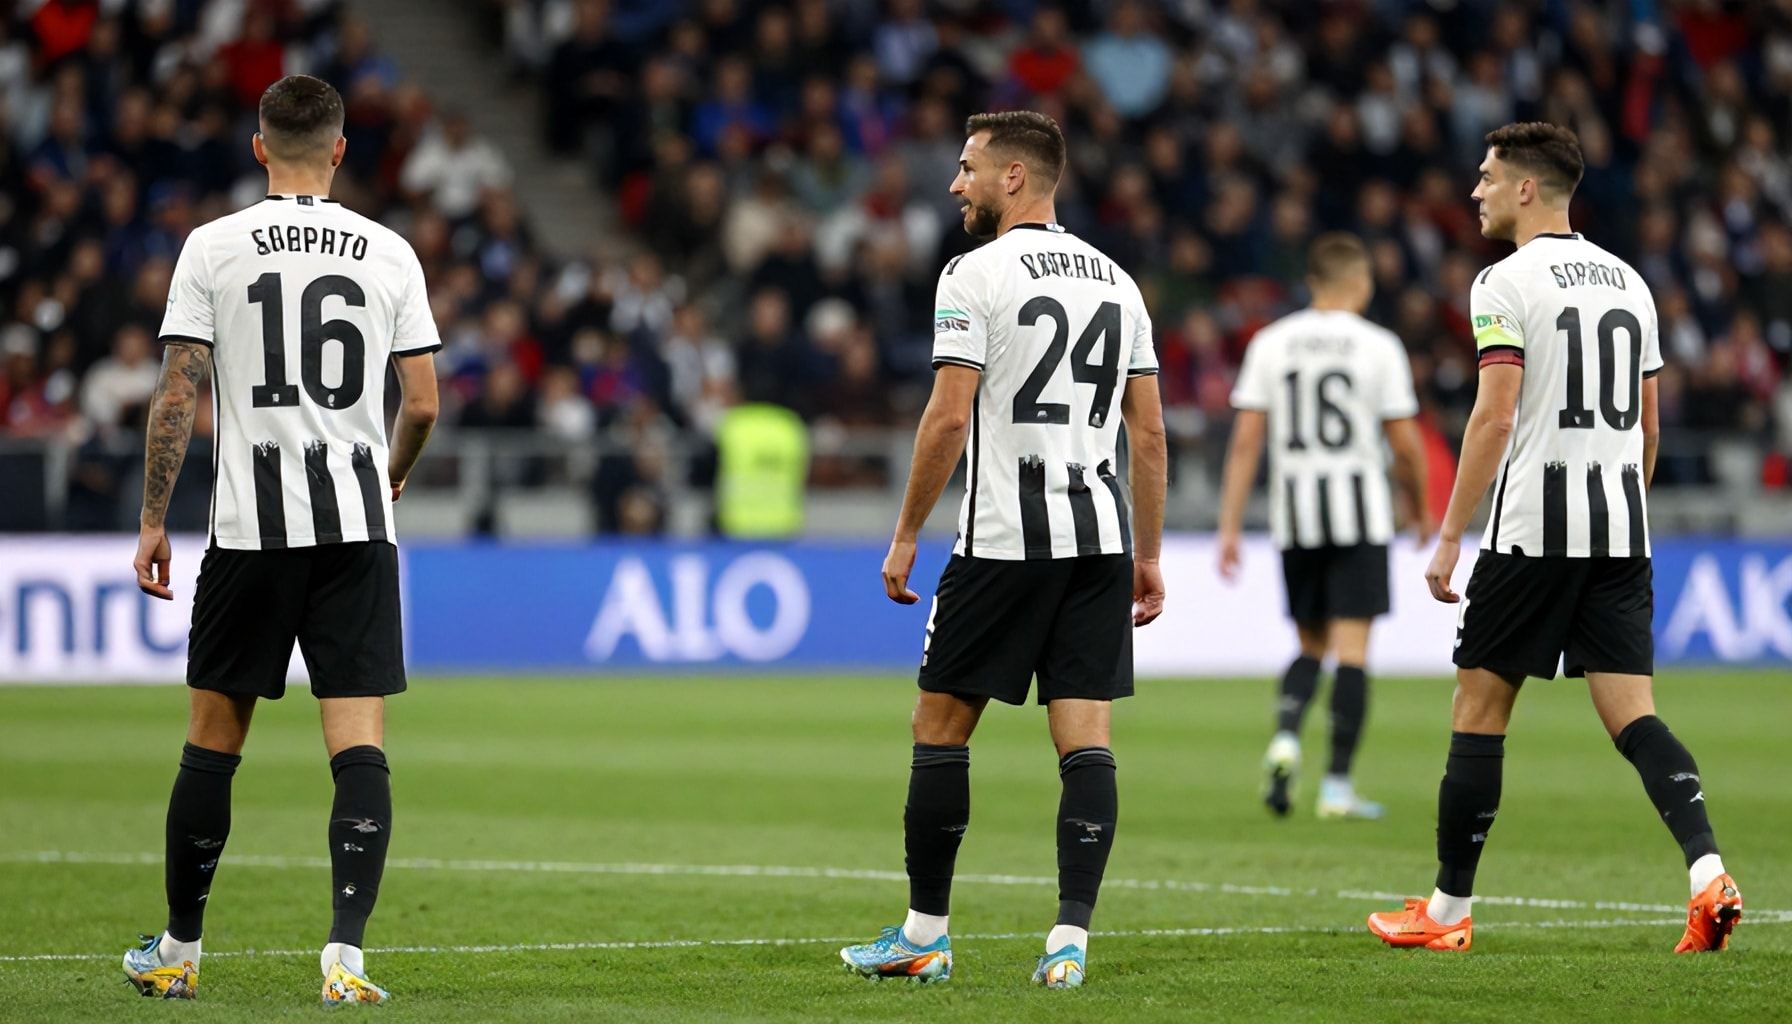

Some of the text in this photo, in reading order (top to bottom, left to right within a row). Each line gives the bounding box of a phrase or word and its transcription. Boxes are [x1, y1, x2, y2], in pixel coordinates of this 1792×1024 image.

[247, 272, 366, 410] 16
[1012, 295, 1121, 428] 24
[1556, 306, 1642, 431] 10
[1284, 370, 1354, 452] 16
